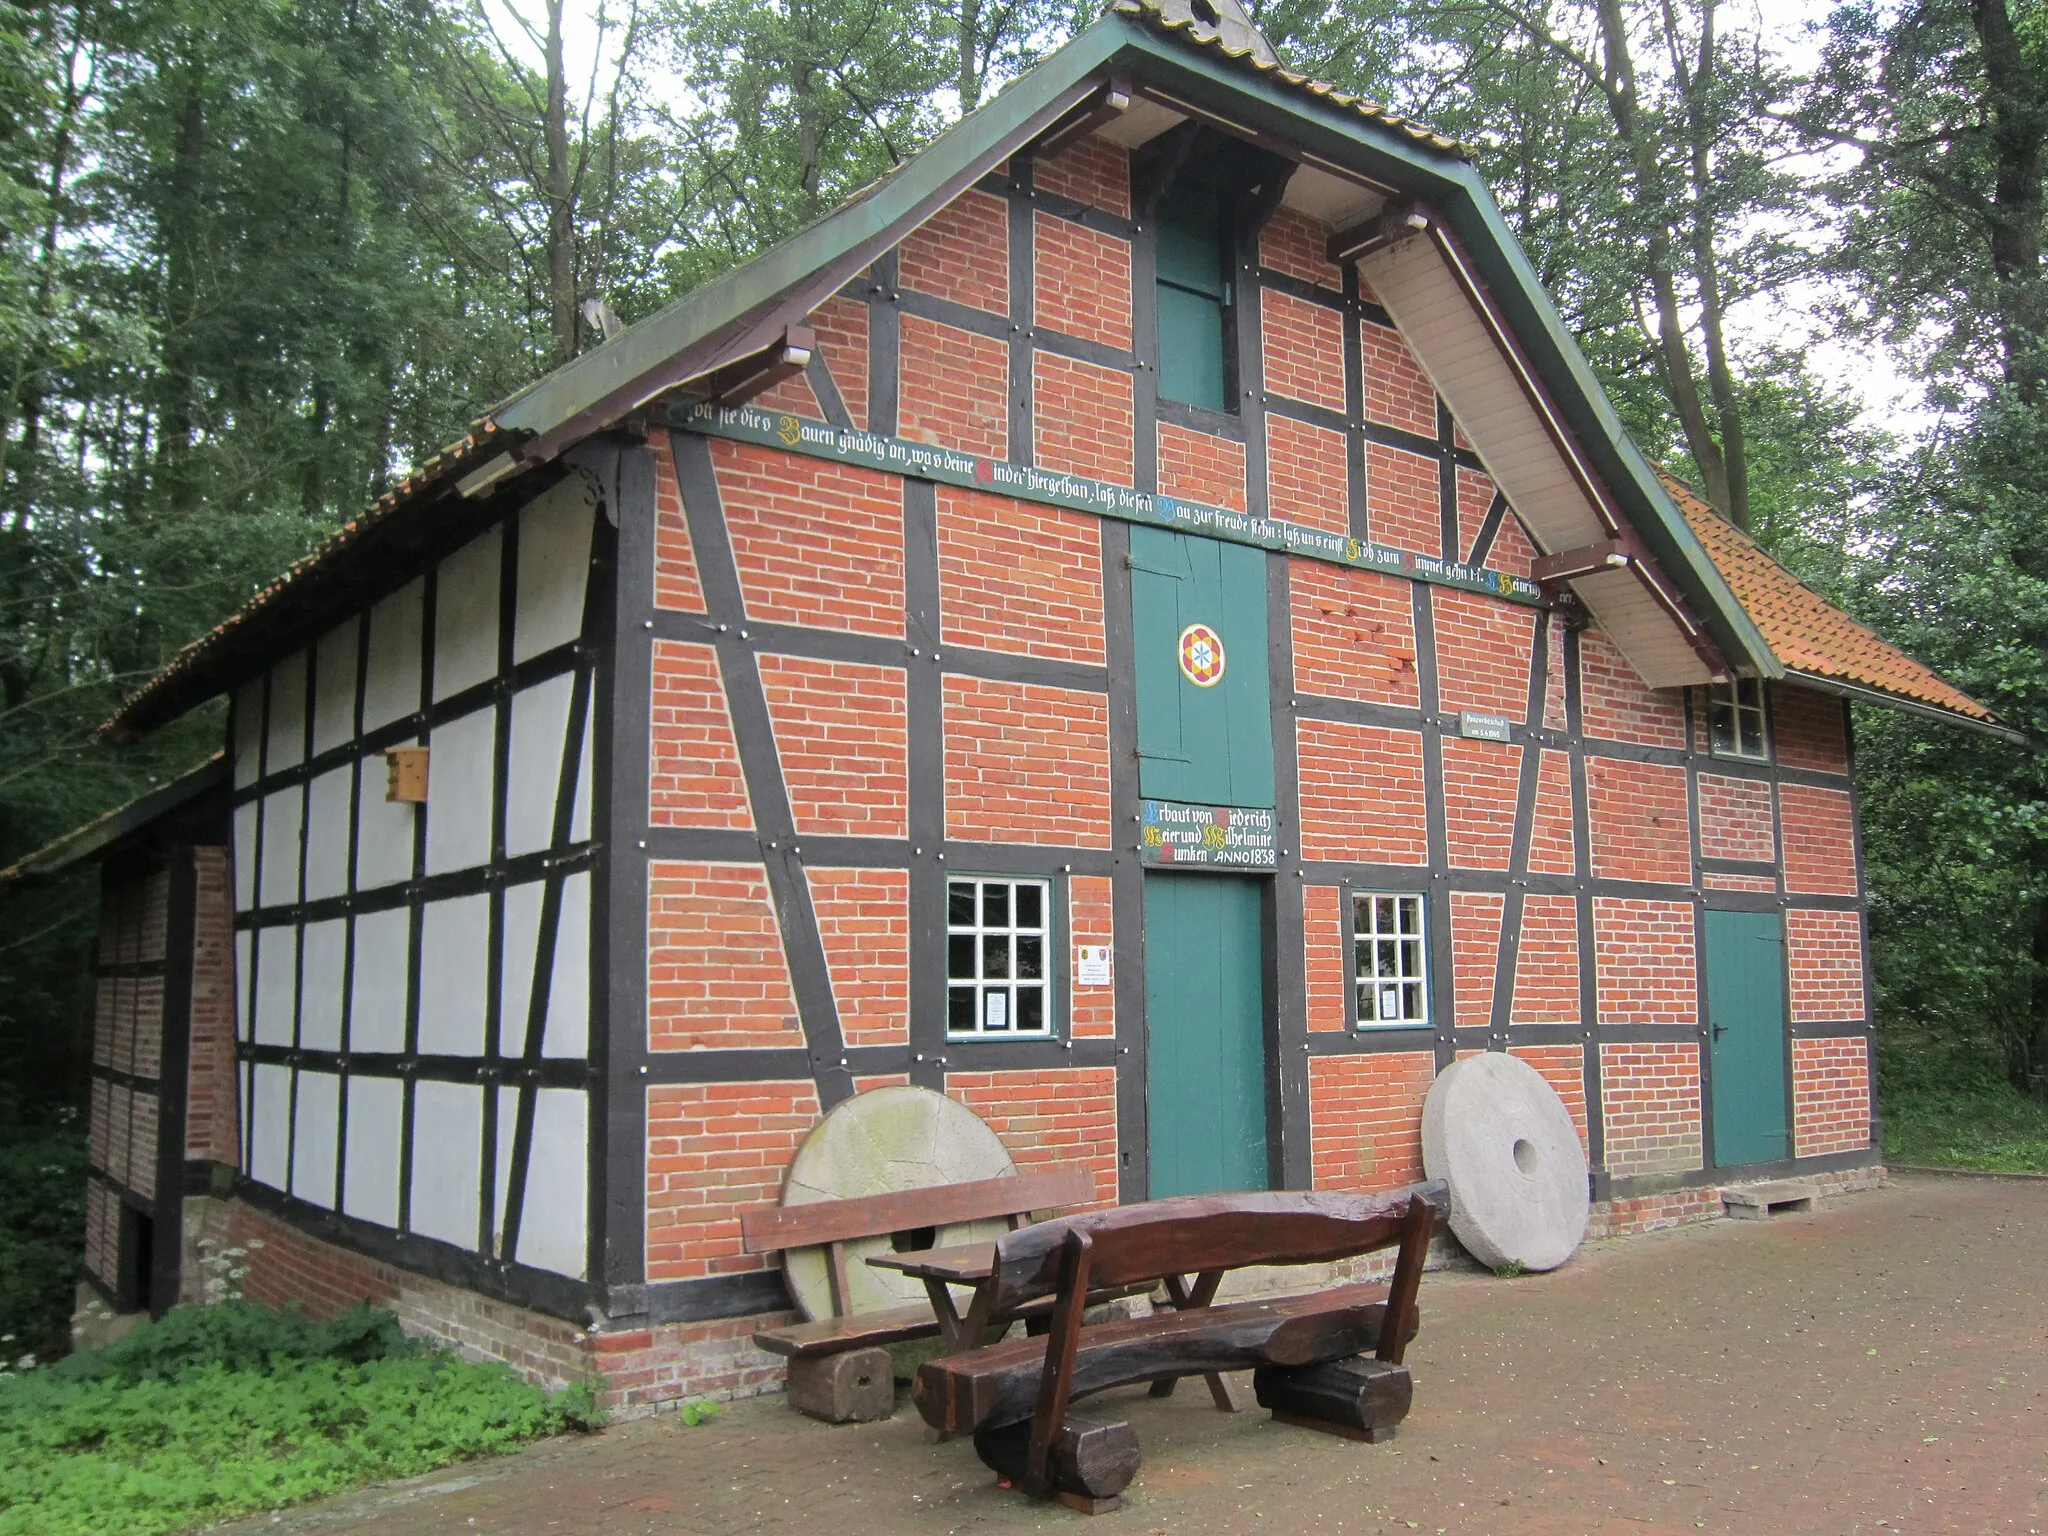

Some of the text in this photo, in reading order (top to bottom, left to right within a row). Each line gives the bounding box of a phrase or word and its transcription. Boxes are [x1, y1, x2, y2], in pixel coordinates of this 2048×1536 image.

[777, 415, 835, 445] Bauen
[944, 450, 974, 474] deine
[1119, 488, 1153, 515] diesen
[1193, 509, 1213, 525] zur
[1376, 549, 1400, 564] zum
[1191, 809, 1213, 824] von
[1182, 824, 1202, 843] und
[1214, 851, 1249, 863] ANNO
[1249, 848, 1275, 865] 1838
